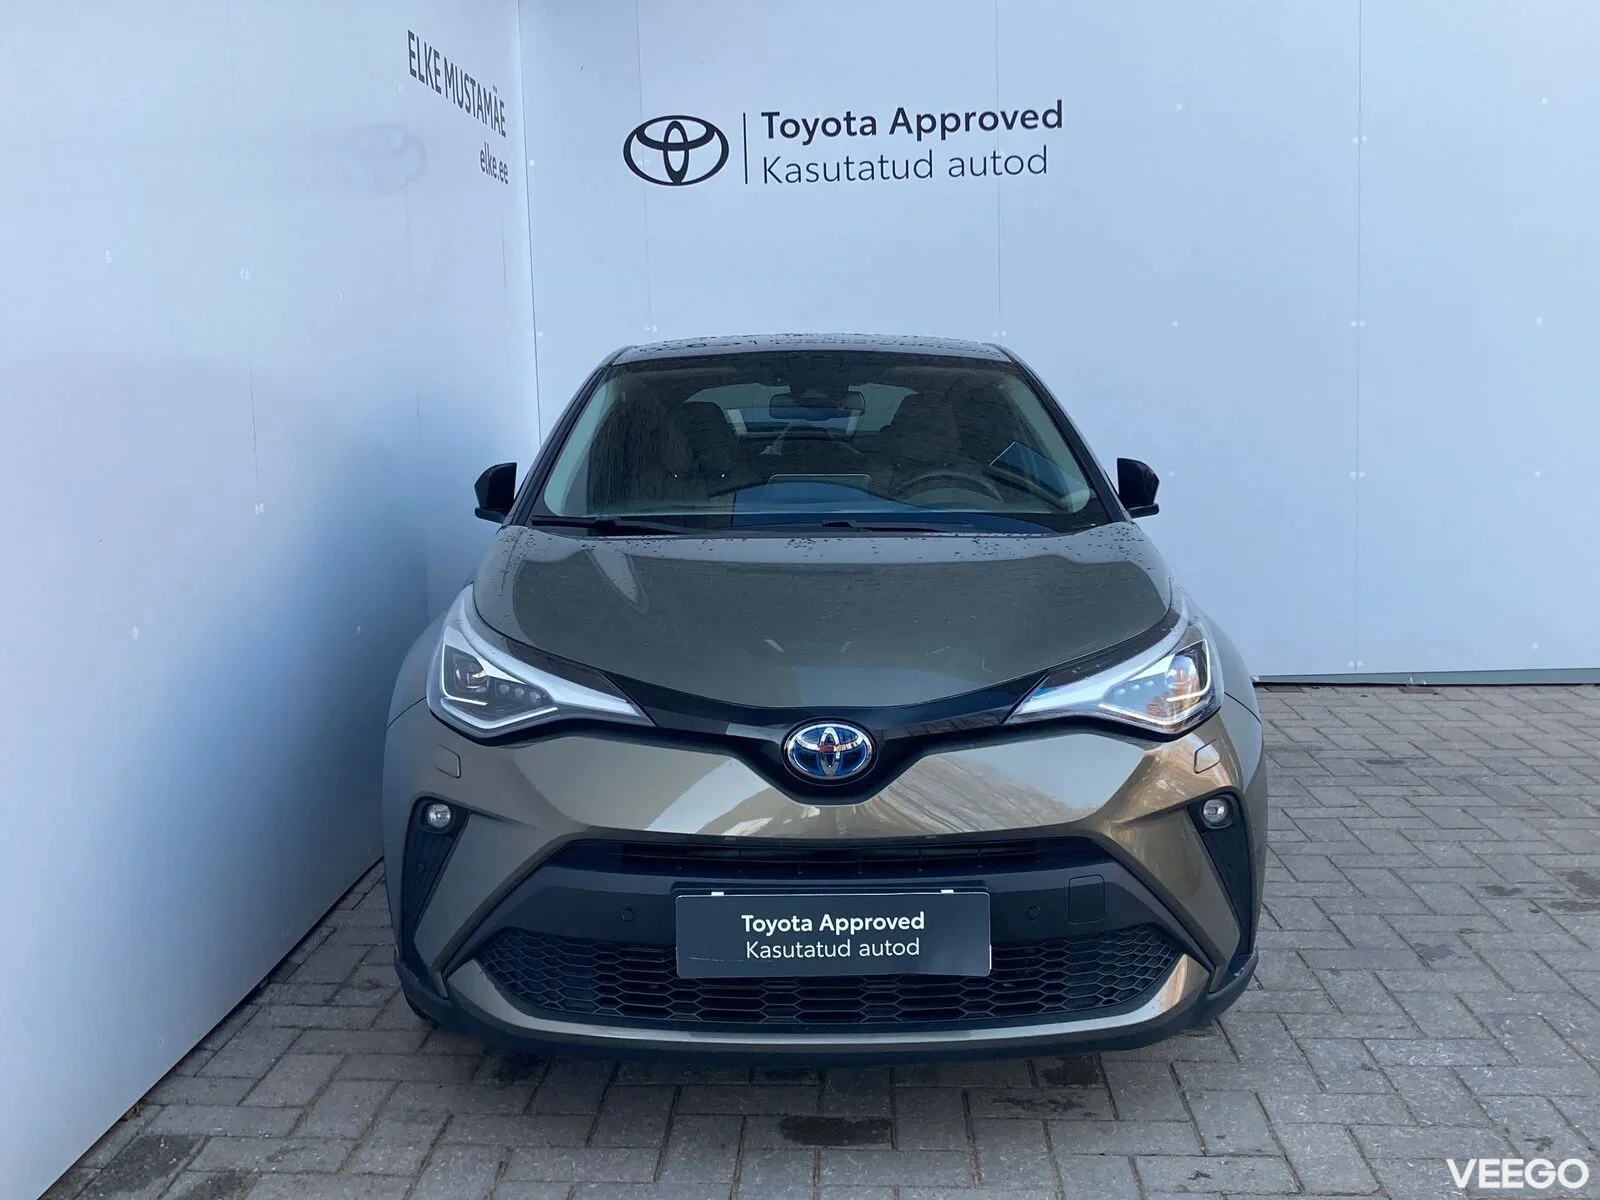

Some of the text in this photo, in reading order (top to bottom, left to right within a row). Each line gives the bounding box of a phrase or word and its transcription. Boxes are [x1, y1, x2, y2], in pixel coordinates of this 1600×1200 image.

[407, 29, 507, 138] ELKE MUSTAMÄE
[761, 99, 1064, 146] Toyota Approved
[479, 141, 509, 185] elke.ee
[763, 144, 1048, 184] Kasutatud autod
[741, 911, 925, 937] Toyota Approved
[746, 937, 920, 960] Kasutatud autod
